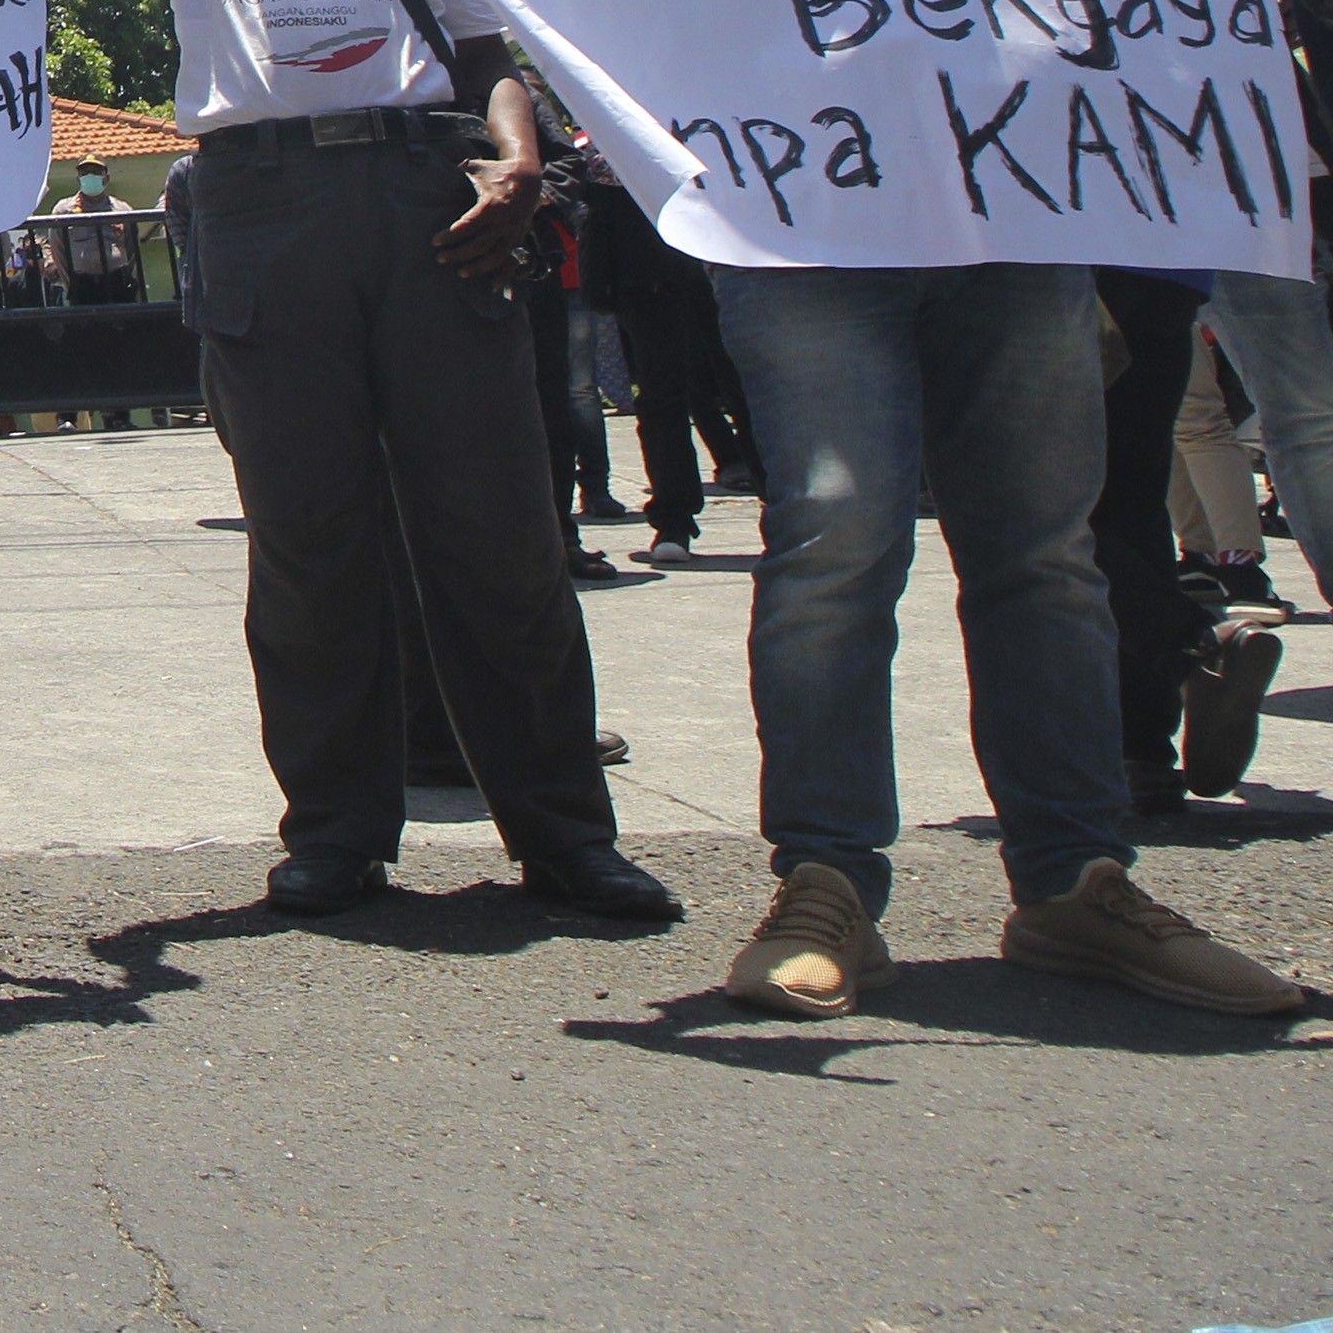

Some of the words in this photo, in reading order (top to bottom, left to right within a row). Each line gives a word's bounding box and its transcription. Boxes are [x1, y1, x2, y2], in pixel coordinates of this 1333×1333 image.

[305, 6, 357, 16] GANGGU
[267, 17, 347, 29] INDONESIAKU
[937, 69, 1293, 228] KAMI
